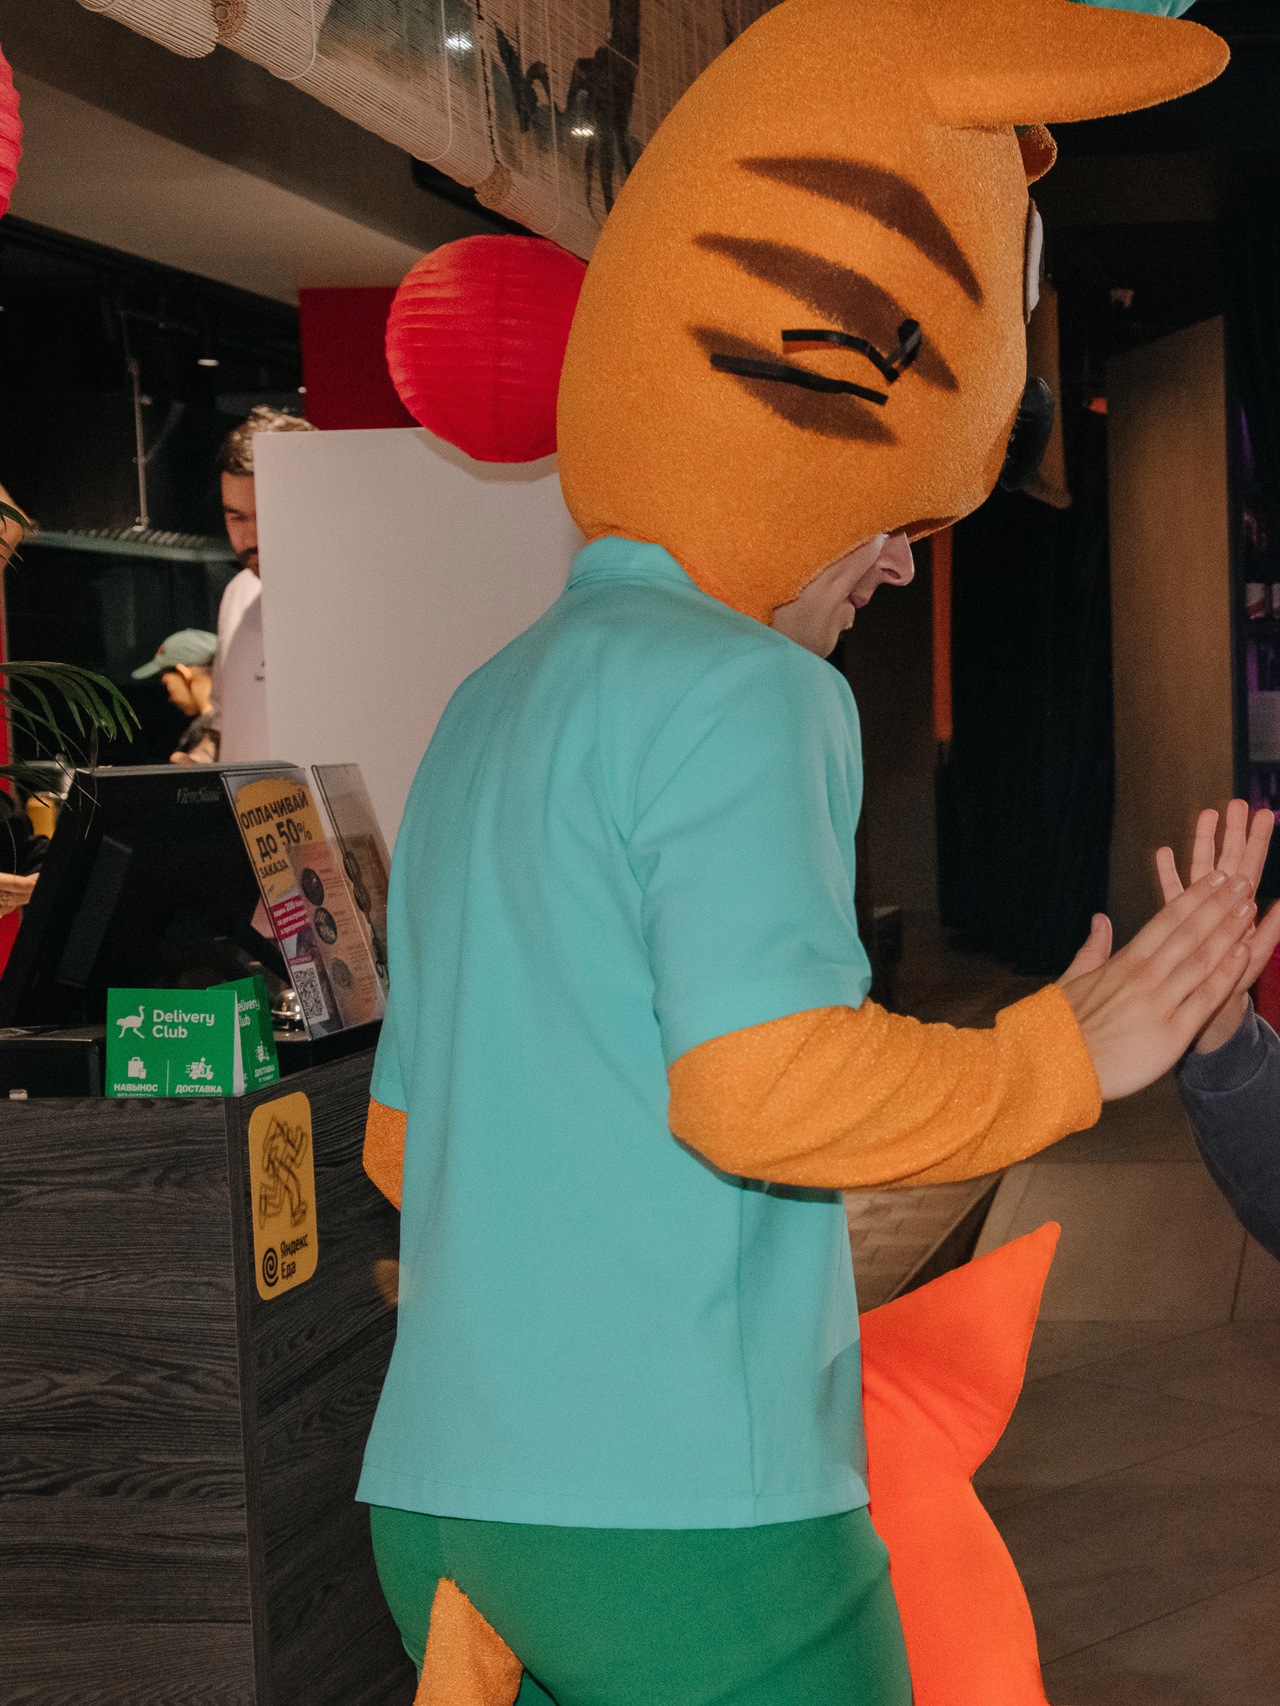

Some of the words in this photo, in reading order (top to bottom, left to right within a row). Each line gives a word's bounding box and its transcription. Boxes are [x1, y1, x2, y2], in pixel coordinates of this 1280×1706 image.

[240, 789, 309, 830] ОПЛАЧИВАЙ
[256, 833, 278, 863] ДО
[275, 818, 312, 845] 50%
[258, 859, 289, 879] ЗАКАЗА
[238, 999, 261, 1014] elivery
[153, 1009, 215, 1027] Delivery
[239, 1015, 251, 1028] lub
[152, 1025, 188, 1038] Club
[113, 1083, 158, 1092] НАВЫНОС
[175, 1084, 222, 1095] ДОСТАВКА
[280, 1233, 309, 1259] Яндекс
[281, 1260, 296, 1281] Еда
